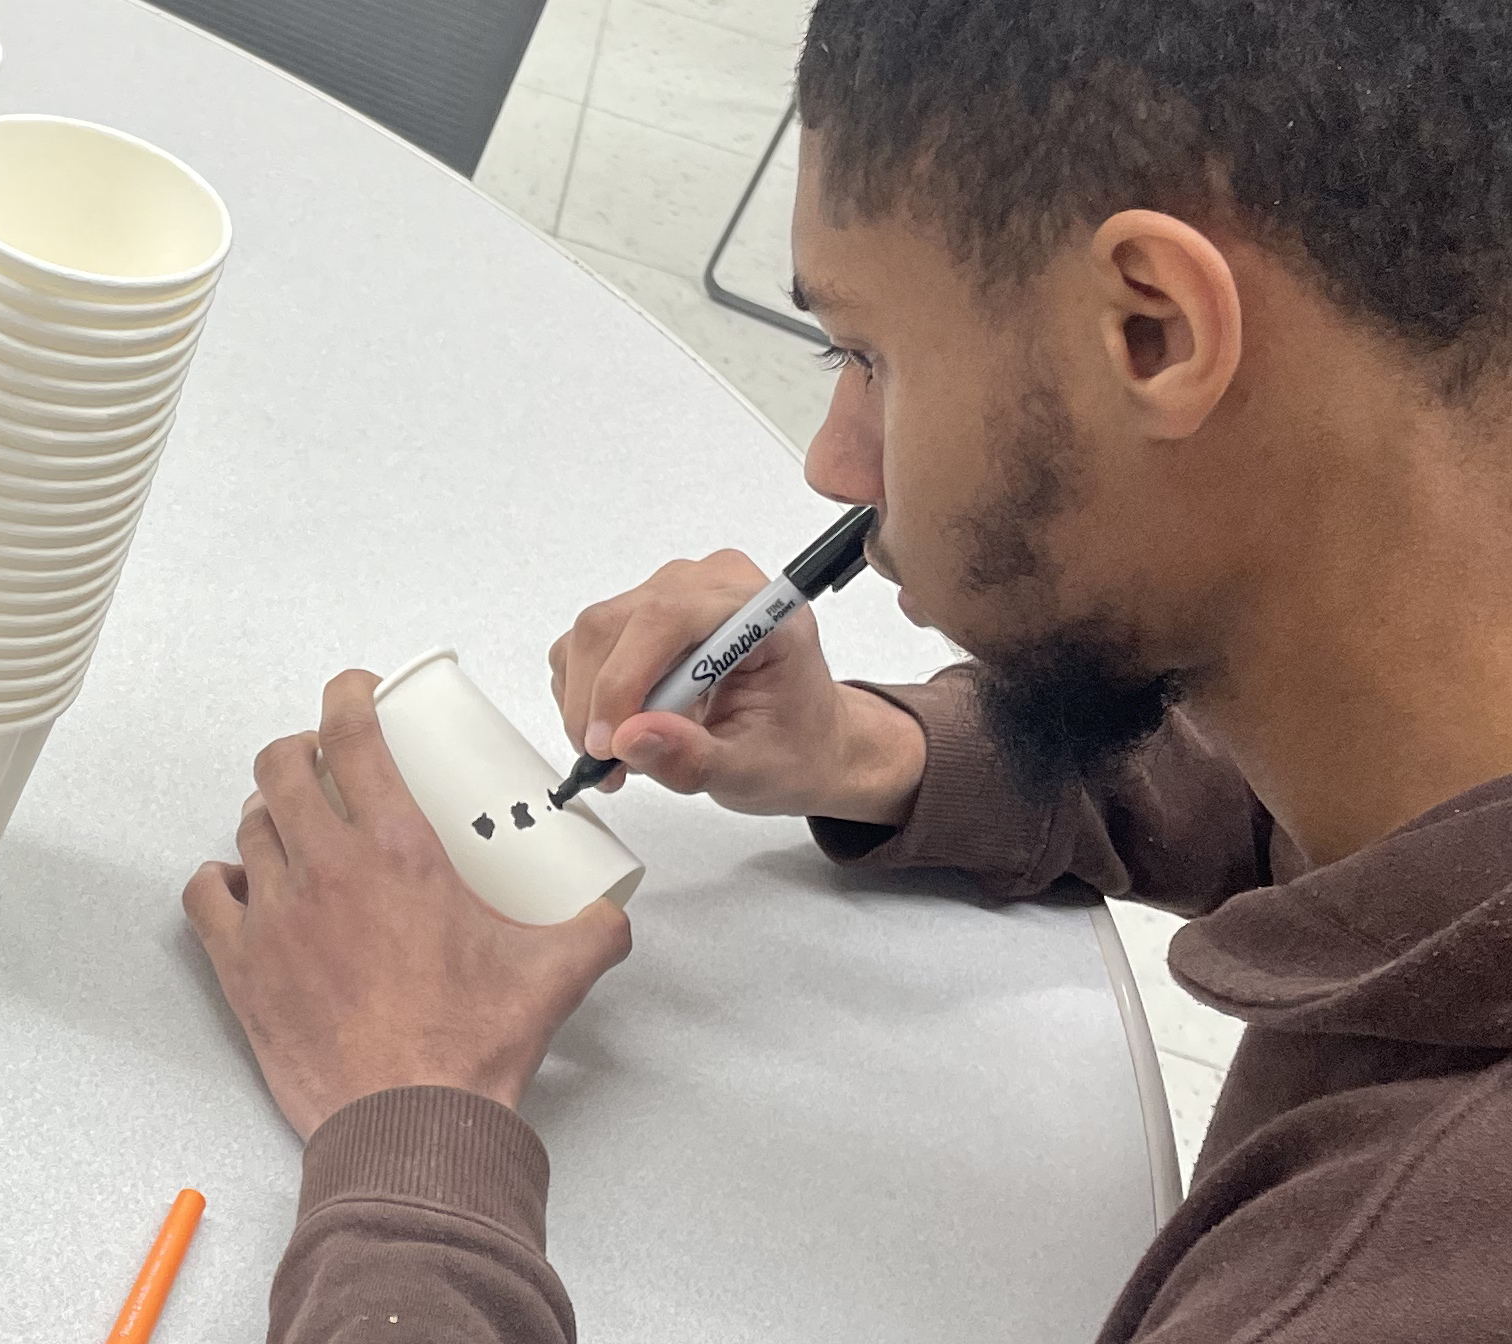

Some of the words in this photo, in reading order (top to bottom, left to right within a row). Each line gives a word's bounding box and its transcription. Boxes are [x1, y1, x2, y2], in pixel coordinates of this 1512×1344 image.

[765, 598, 785, 618] FINE
[772, 600, 796, 623] POINT
[691, 623, 768, 697] Sharpie
